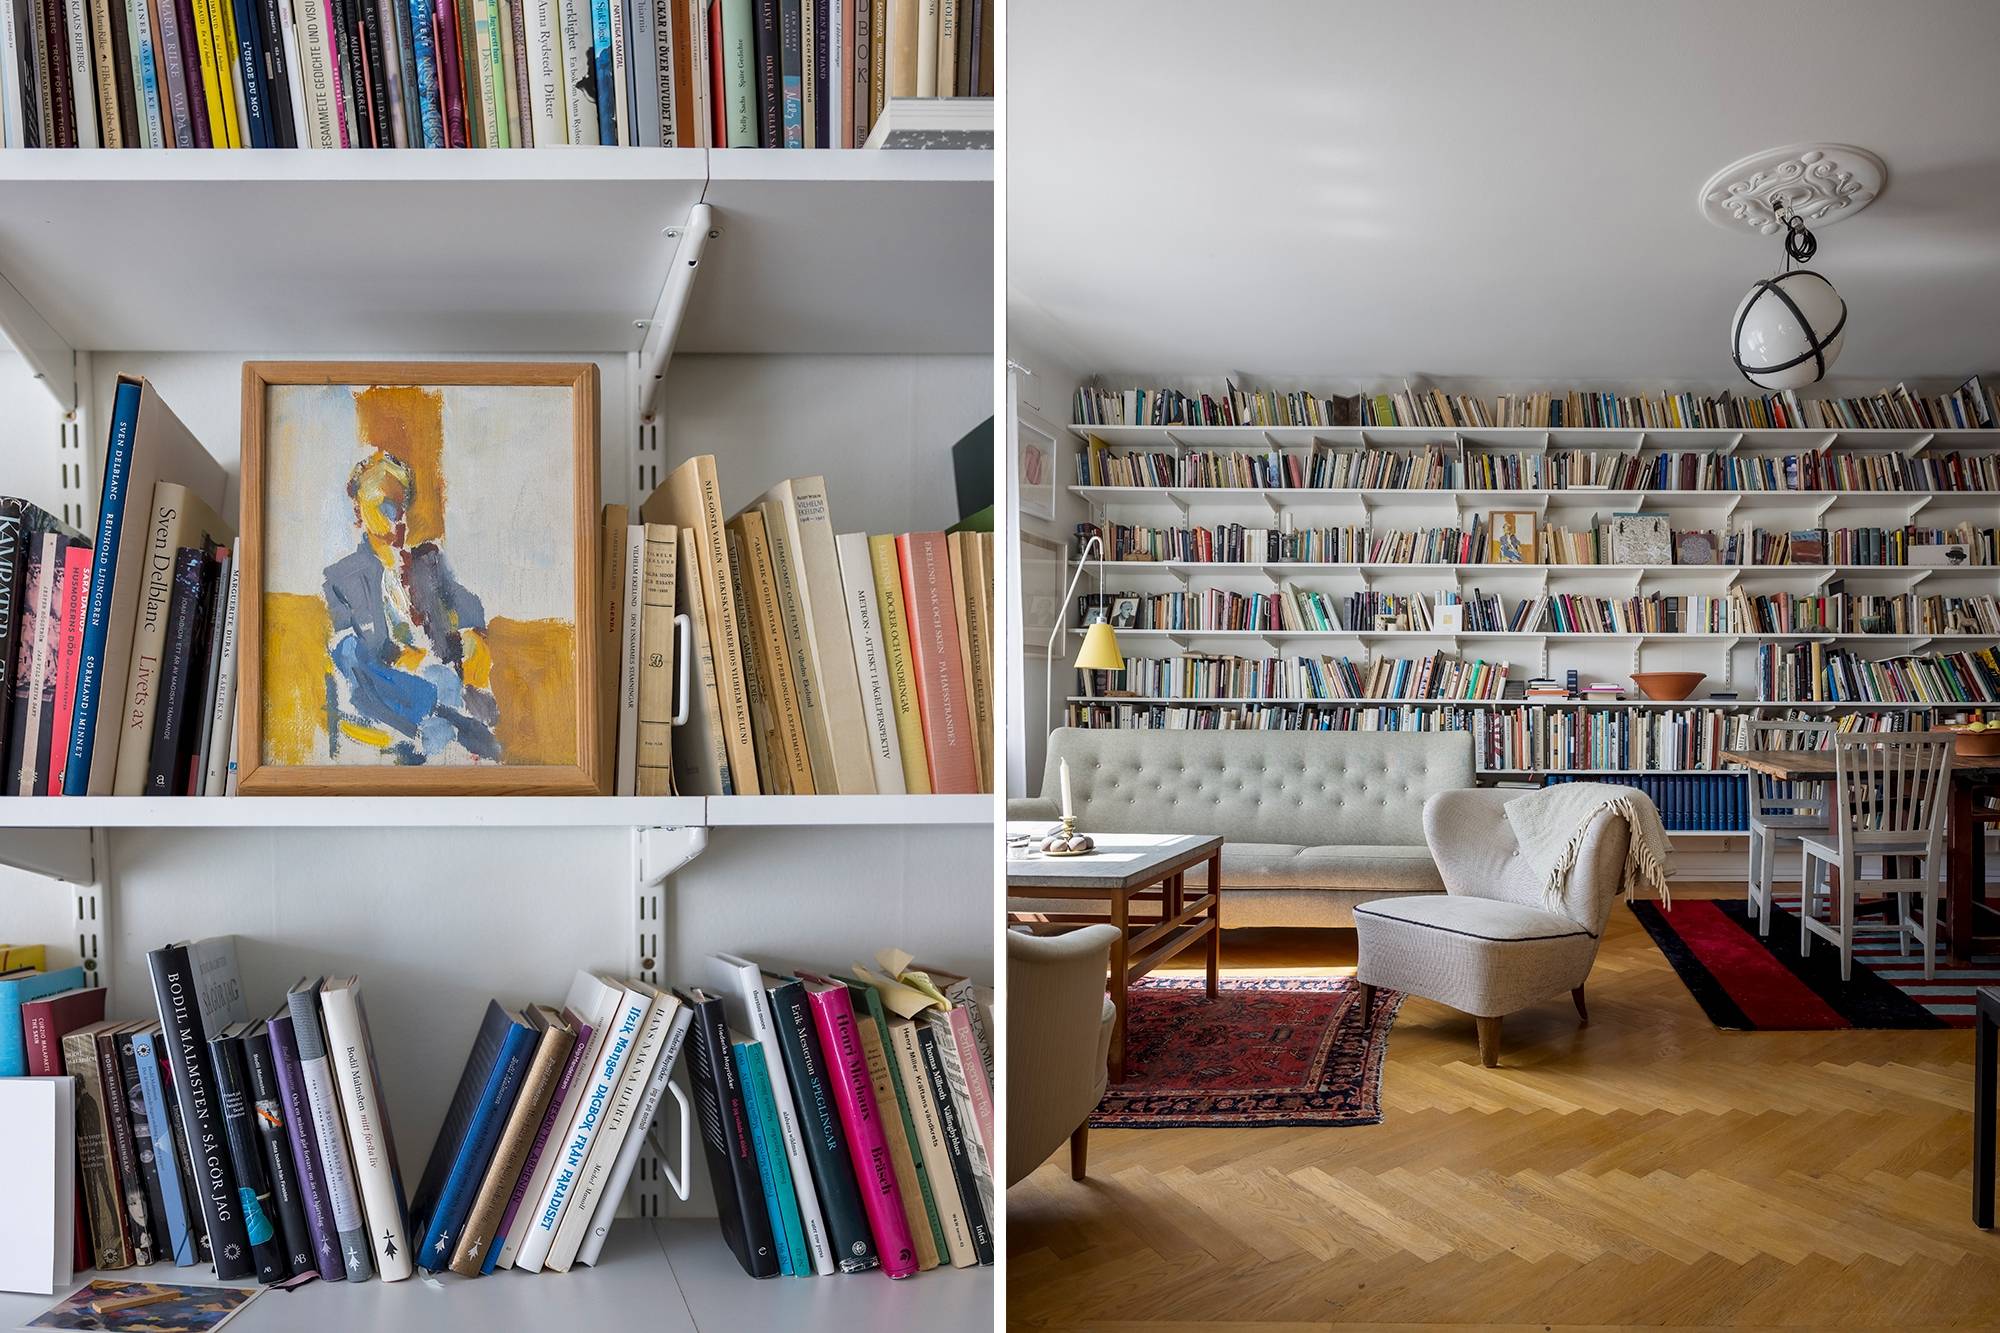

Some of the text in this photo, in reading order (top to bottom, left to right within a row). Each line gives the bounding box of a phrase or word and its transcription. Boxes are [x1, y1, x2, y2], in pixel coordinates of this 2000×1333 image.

[71, 1, 86, 73] KLAUS RIFBJERG
[308, 24, 326, 89] GEDICHTE UND
[538, 0, 555, 119] Anna Rydstedt Dikter
[598, 21, 608, 42] Fågel
[763, 2, 775, 103] LIVET DIKTER AV
[820, 29, 826, 40] ÄR
[820, 43, 825, 53] EN
[142, 39, 156, 109] MARIA RILKE
[168, 43, 186, 129] RILKE VALDA
[243, 41, 260, 119] L'USAGE DU MOT
[351, 36, 366, 116] MJUKA MÖRKRET
[375, 83, 387, 129] HEJDAD
[569, 57, 580, 117] En bok Anna
[658, 30, 675, 136] UT ÖVER HUVUDET PÅ
[784, 90, 800, 119] Nelly
[740, 114, 748, 133] Nelly
[66, 567, 79, 656] HUSMODERNS DÖD
[75, 421, 128, 758] SVEN DELBLANC REINHOLD LJUNGGREN SÖRMLAND MINNET
[82, 568, 90, 593] SARA
[131, 506, 177, 731] Sven Delblanc Livets ax
[608, 600, 616, 633] AGENDA
[704, 480, 748, 745] NILS GÖSTA VALDÉN GREKISKA TERMER HOS VILHELM EKELUND
[174, 655, 182, 665] ÅR
[175, 642, 183, 654] ETT
[177, 615, 186, 640] DIDION
[216, 569, 240, 721] MARGUERITE DURAS KÄRLEKEN
[776, 538, 814, 708] HEMKOMST OCH FLYKT Vilhelm Ekelund
[885, 591, 910, 714] BÖCKER OCH VANDRINGAR
[923, 541, 956, 747] EKELUND SAK OCH SKEN PÅ HAFSSTRANDEN
[168, 676, 177, 705] MAGISKT
[627, 666, 636, 709] STÄMNINGAR
[763, 587, 803, 773] GEIJERSTAM DET PERSONLIGA EXPERIMENTET
[857, 590, 891, 760] METRON ATTISKT FÅGELPERSPEKTIV
[163, 706, 175, 740] TÄNKANDE
[167, 972, 190, 1024] BODIL
[104, 1054, 119, 1113] BODIL MALMSTEN
[179, 1028, 209, 1119] MALMSTEN
[253, 1054, 266, 1096] Bodil Malmsten
[656, 1028, 685, 1082] Friederike Mayröcker
[717, 1023, 735, 1090] Friederike Mayröcker
[752, 990, 798, 1157] thurston moore alabama wildman
[791, 1004, 838, 1151] Erik Mesterton SPEGLINGAR
[903, 1027, 939, 1147] Henry Miller Kräftans vändkrets
[202, 1133, 218, 1152] SÅ
[345, 1046, 377, 1169] Bodil Malmsten mitt första liv
[512, 1042, 586, 1203] Osip Mandelstam RESAN ARMENIEN
[541, 1006, 642, 1231] Itzik Manger DAGBOK FRÅN PARADISET
[578, 1007, 666, 1211] HANS NAKNA HJÄRTA Michel Manoll
[836, 1013, 892, 1195] Henri Michaux Bräsch
[924, 1041, 986, 1245] Thomas Millroth Vällingbyblues Inferi
[207, 1156, 224, 1191] GÖR
[292, 1093, 324, 1228] Och månad fortare hjärtslag
[212, 1194, 231, 1222] JAG
